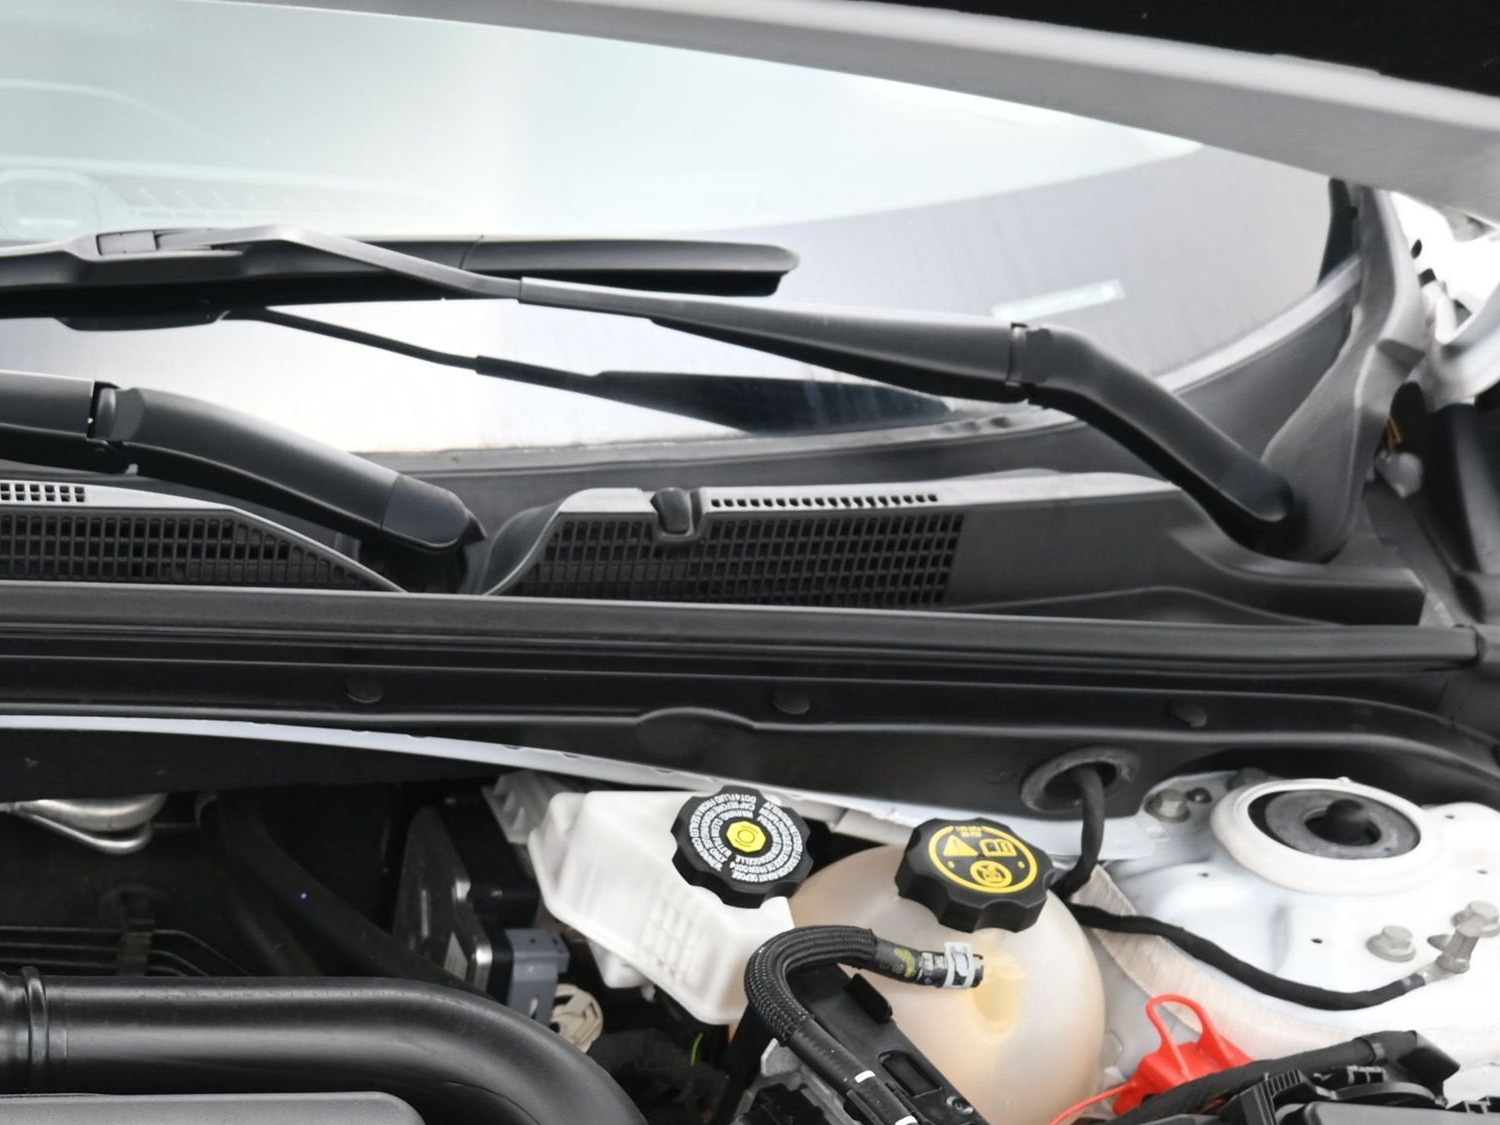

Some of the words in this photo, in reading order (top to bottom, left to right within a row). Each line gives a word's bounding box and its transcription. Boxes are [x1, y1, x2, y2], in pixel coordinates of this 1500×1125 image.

[713, 793, 734, 803] FLUID
[740, 794, 757, 804] DOT
[709, 847, 728, 864] ONLY
